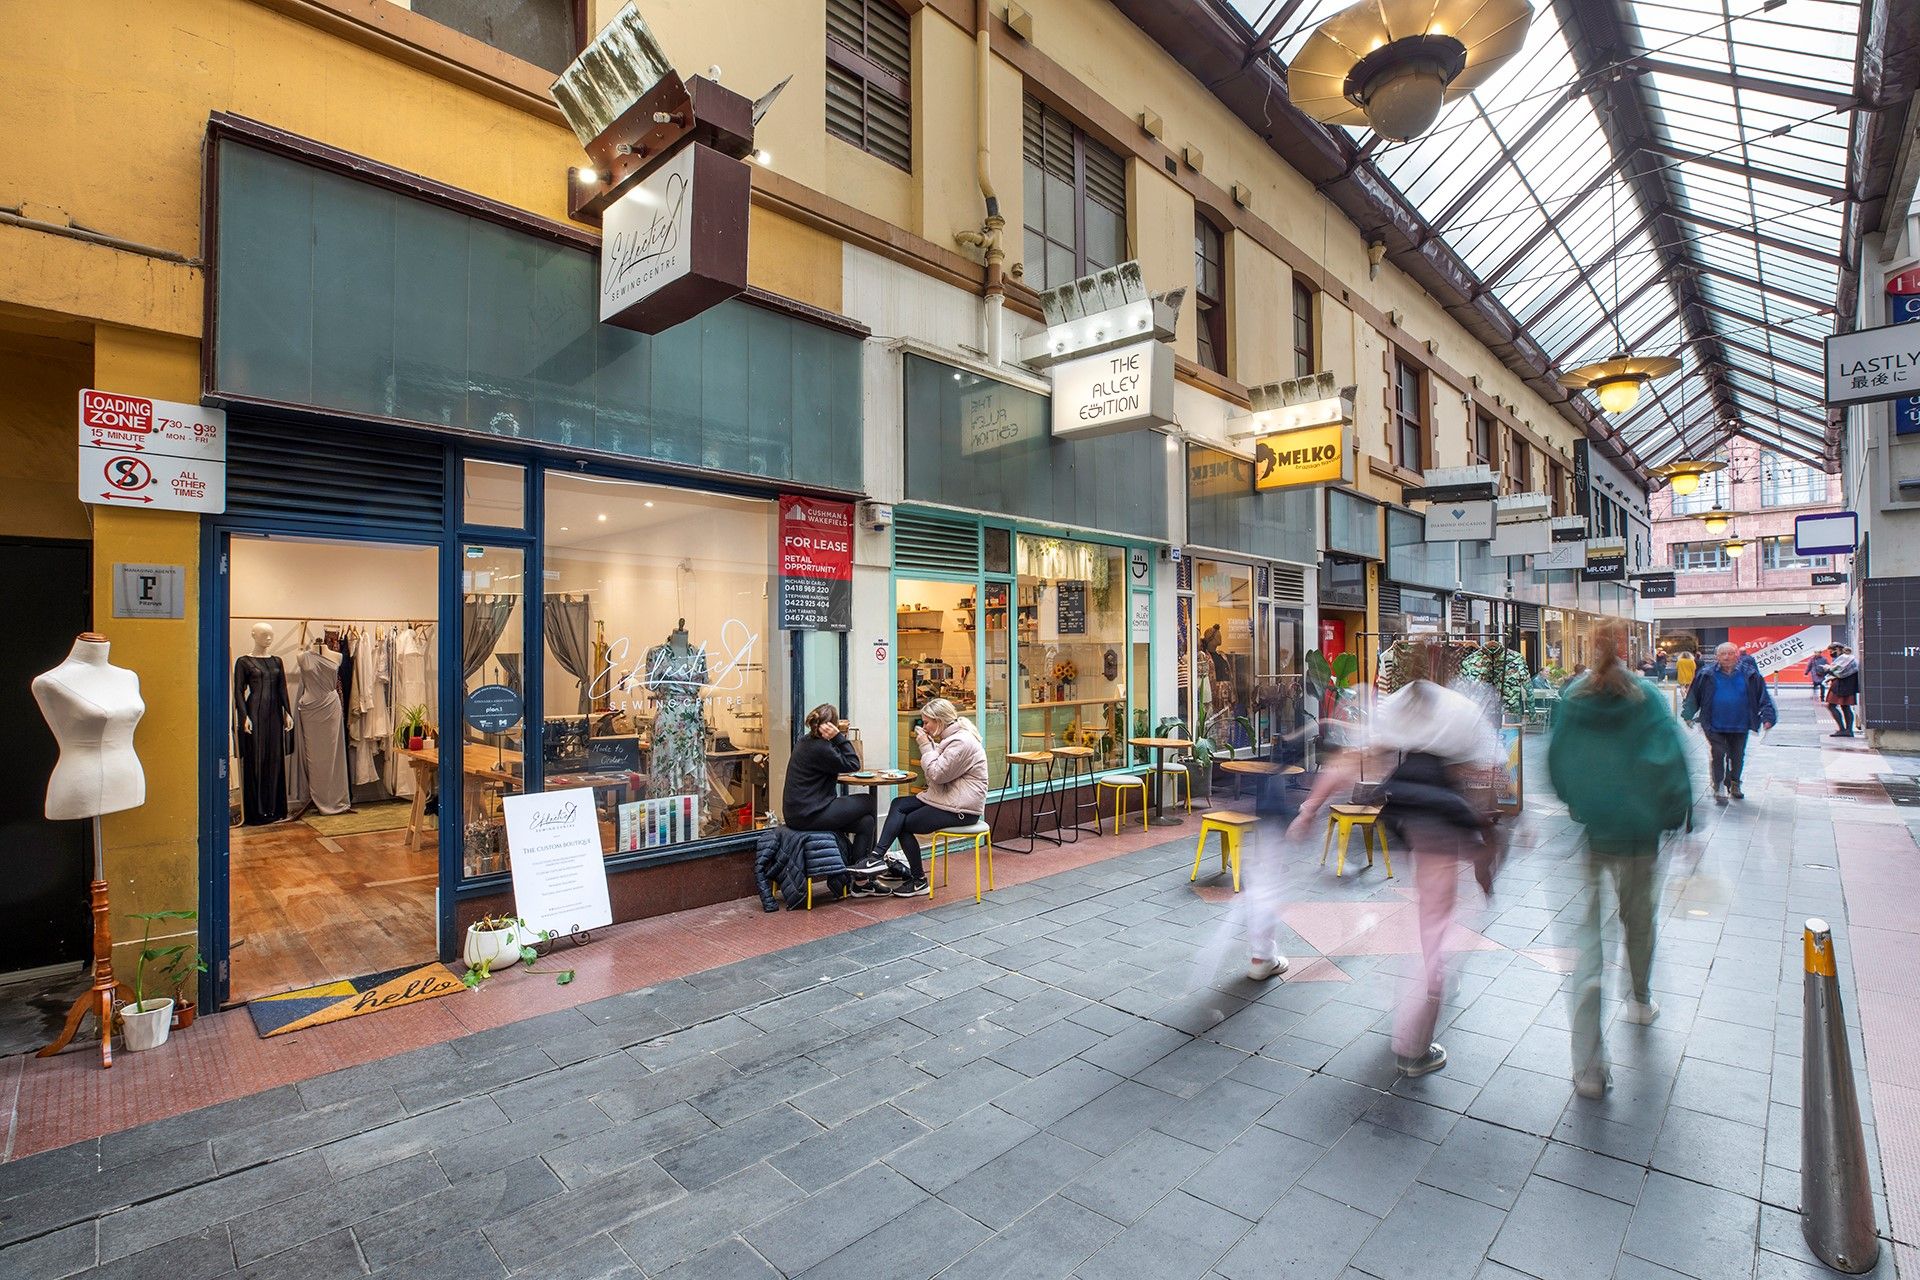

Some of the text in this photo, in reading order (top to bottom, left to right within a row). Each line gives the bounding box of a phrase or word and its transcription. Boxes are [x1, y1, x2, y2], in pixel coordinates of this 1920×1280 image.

[611, 256, 676, 301] SEWING CENTRE
[1110, 353, 1140, 374] THE
[1092, 374, 1139, 399] ALLEY
[85, 395, 151, 417] LOADING
[90, 409, 147, 429] ZONE
[92, 428, 145, 442] 15 MINUTE
[1278, 444, 1336, 467] MELKO
[180, 471, 198, 480] ALL
[171, 479, 206, 489] OTHER
[173, 488, 204, 498] TIMES
[808, 509, 842, 519] CUSHMAN
[808, 516, 848, 526] WAKEFIELD
[785, 536, 848, 552] FOR LEASE
[785, 555, 812, 564] RETAIL
[785, 563, 836, 573] OPPORTUNITY
[140, 576, 156, 600] F
[1780, 637, 1801, 649] EXTRA
[1756, 642, 1805, 668] 30% OFF
[609, 696, 742, 711] SEWING CENTRE
[353, 977, 458, 1012] hello
